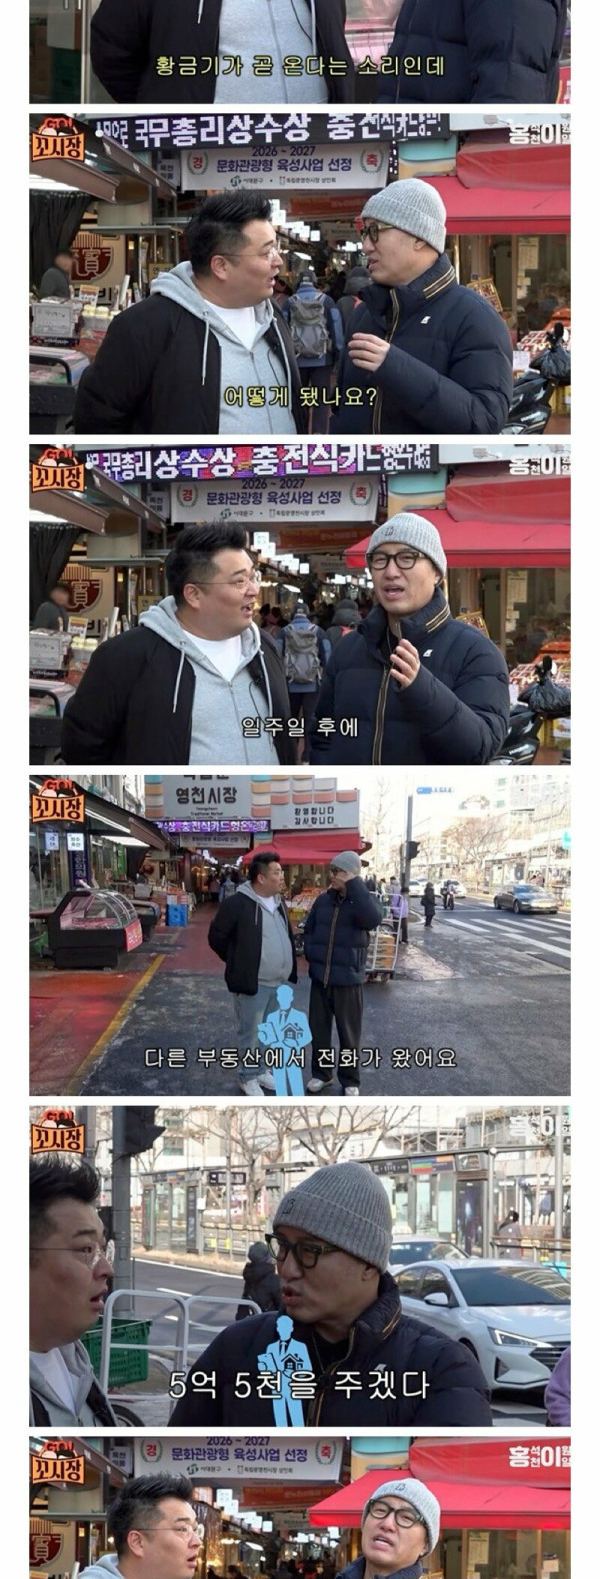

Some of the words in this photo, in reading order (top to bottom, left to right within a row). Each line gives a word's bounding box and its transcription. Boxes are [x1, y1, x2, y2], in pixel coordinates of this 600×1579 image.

[216, 159, 273, 173] 문화관광형
[277, 158, 324, 172] 육성사업
[328, 158, 352, 172] 선정
[175, 787, 237, 805] 영천시장
